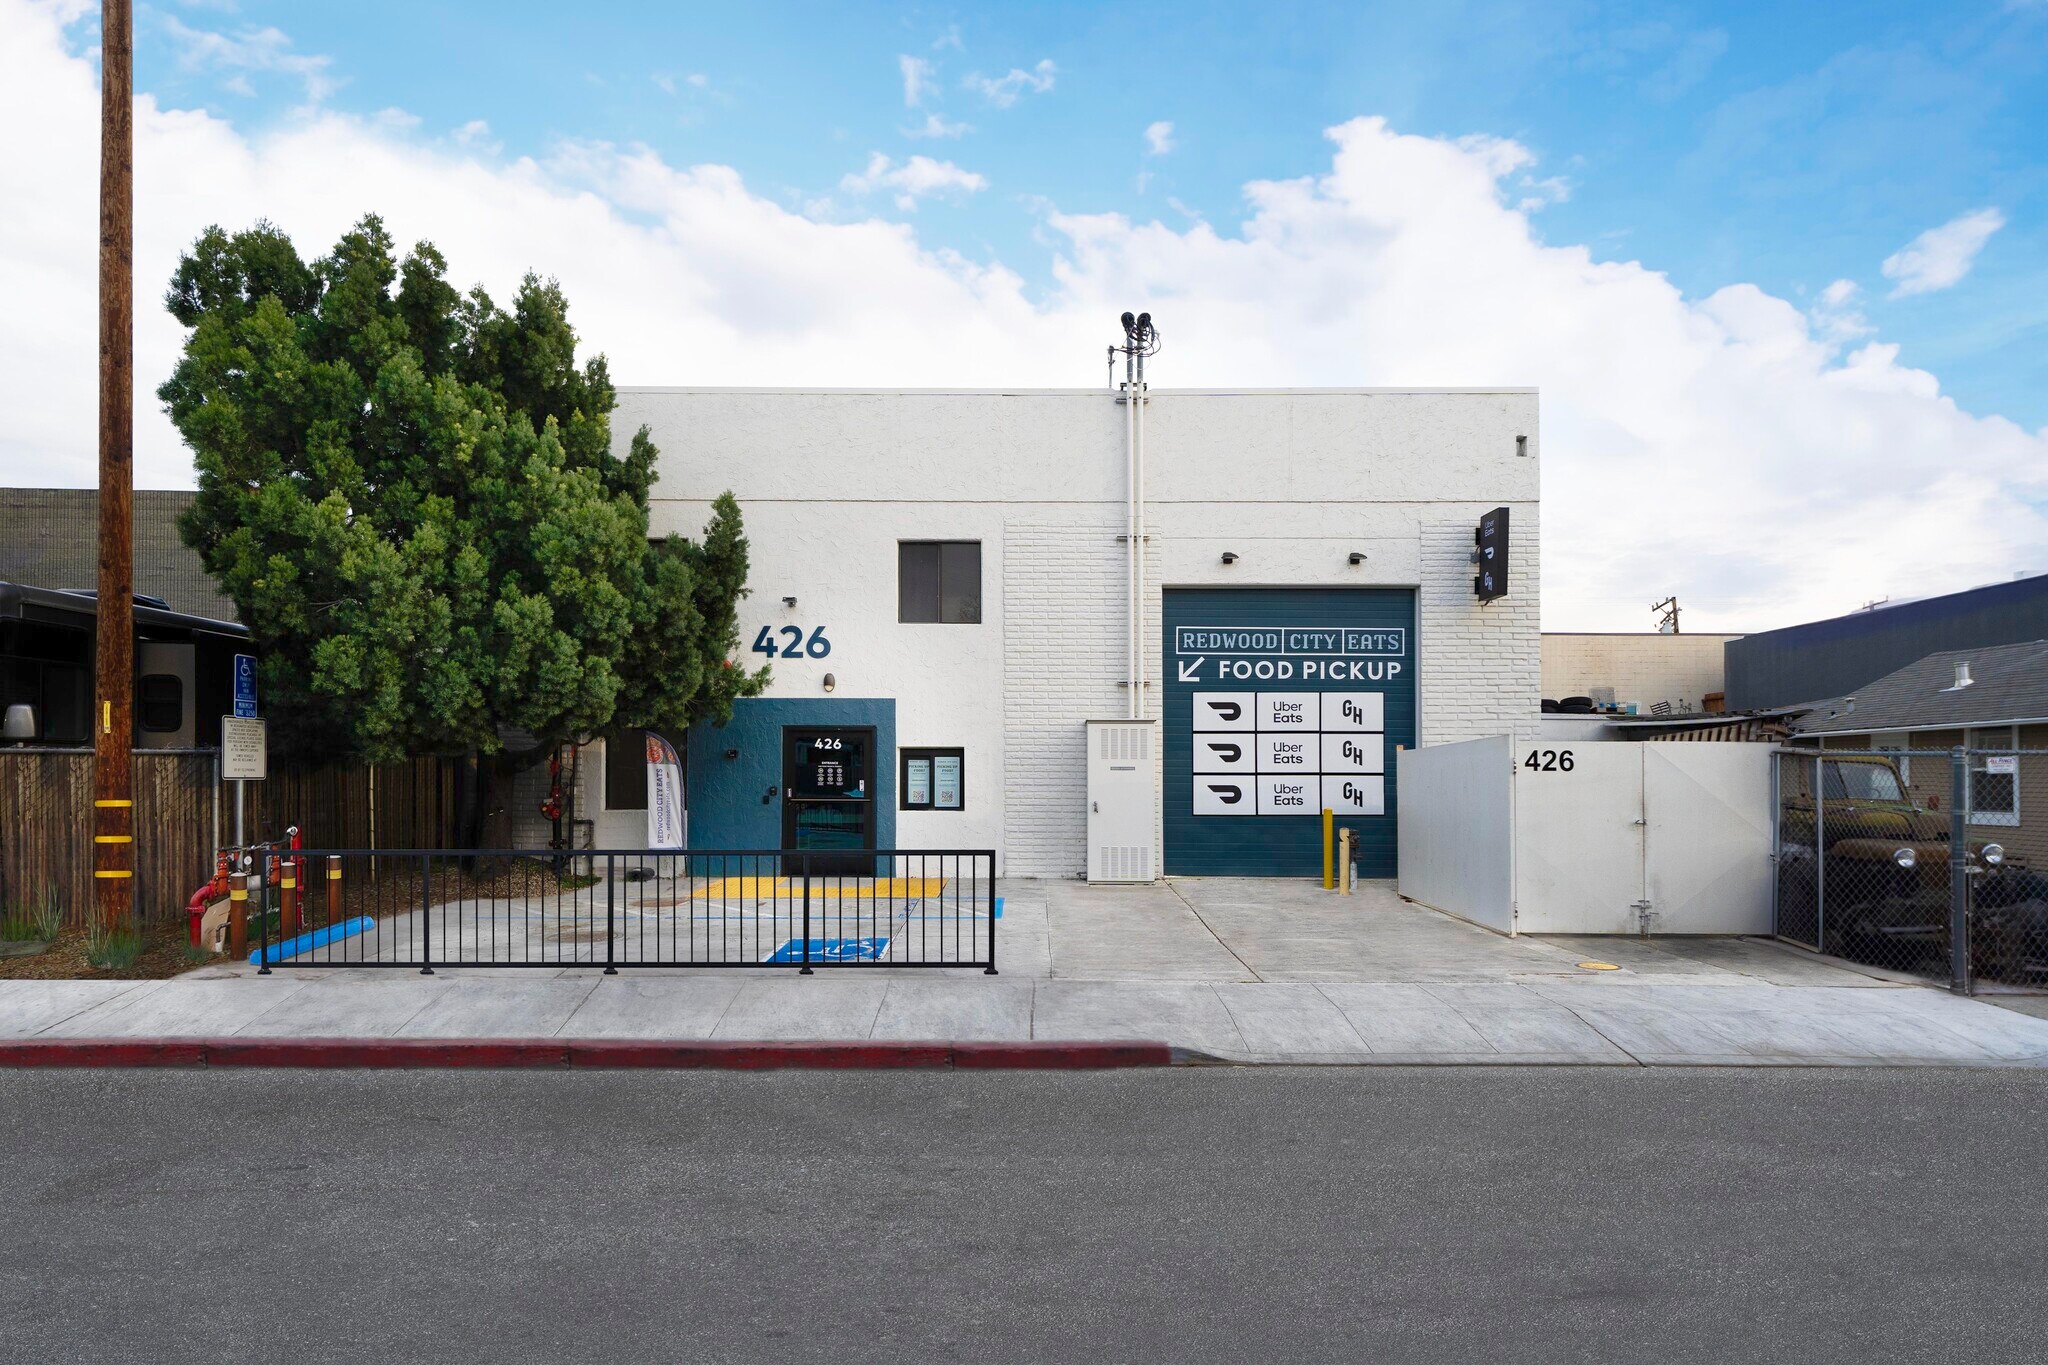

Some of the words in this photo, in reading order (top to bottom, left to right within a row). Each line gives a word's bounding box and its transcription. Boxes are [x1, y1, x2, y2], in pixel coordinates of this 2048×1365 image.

[752, 625, 831, 658] 426
[1183, 632, 1278, 649] REDWOOD
[1290, 634, 1336, 650] CITY
[1347, 635, 1399, 651] EATS
[1219, 660, 1294, 680] FOOD
[1302, 661, 1402, 681] PICKUP
[1273, 701, 1303, 712] Uber
[1273, 713, 1304, 724] Eats
[814, 738, 842, 750] 426
[1273, 742, 1303, 753] Uber
[1273, 754, 1304, 765] Eats
[1524, 750, 1575, 772] 426
[1273, 783, 1303, 794] Uber
[656, 788, 664, 806] CITY
[1273, 795, 1304, 806] Eats
